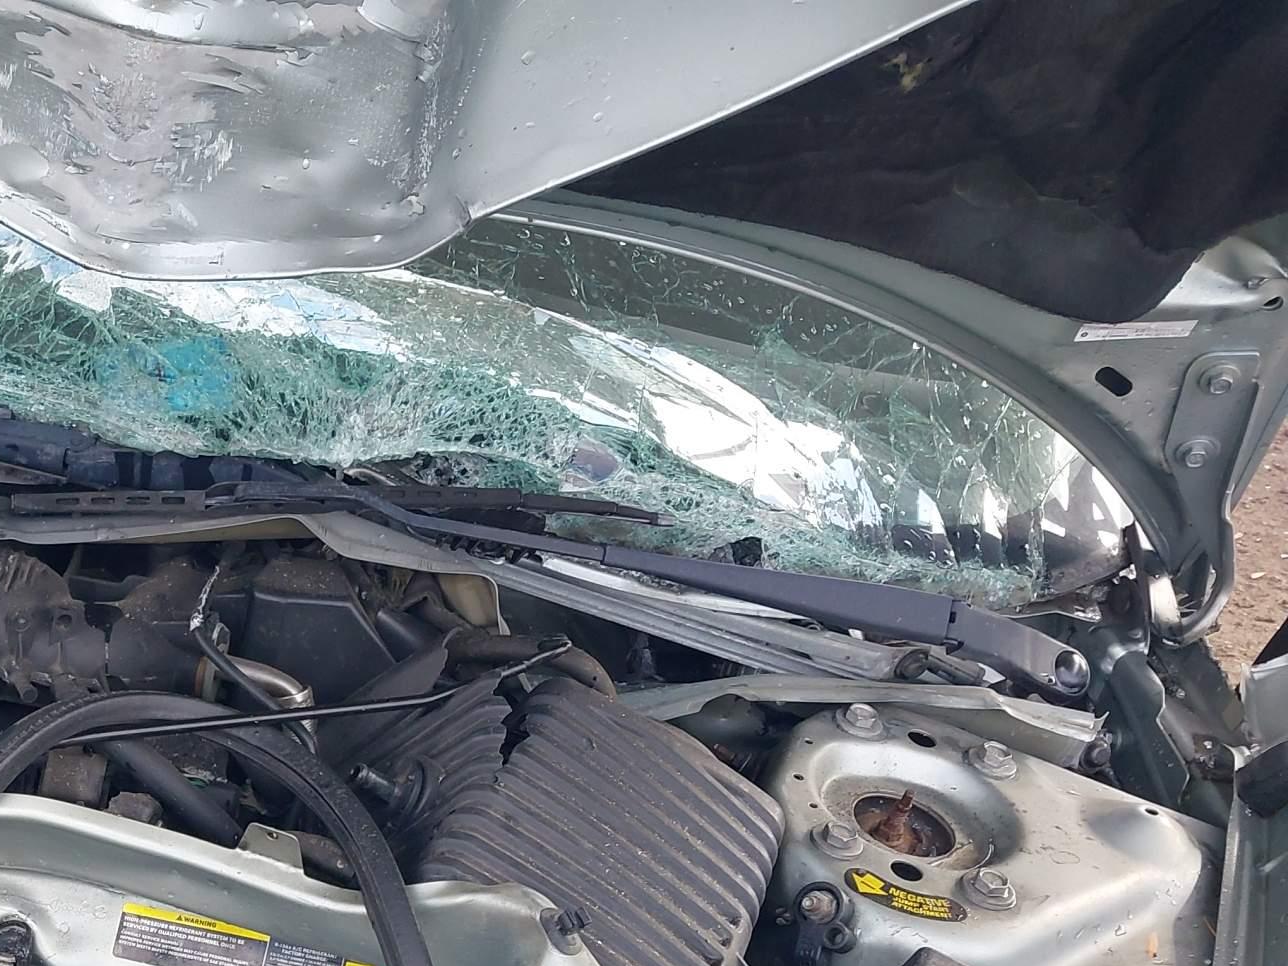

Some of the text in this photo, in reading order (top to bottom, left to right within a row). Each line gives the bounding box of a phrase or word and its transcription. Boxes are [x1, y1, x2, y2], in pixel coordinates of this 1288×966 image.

[889, 887, 952, 907] NEGATIVE
[891, 902, 953, 918] ATTACHMENT
[183, 916, 217, 929] WARNING
[123, 921, 149, 932] SERVICED
[158, 929, 187, 940] QUALIFIED
[187, 935, 220, 947] PERSONNEL
[168, 925, 206, 937] REFRIGERANT
